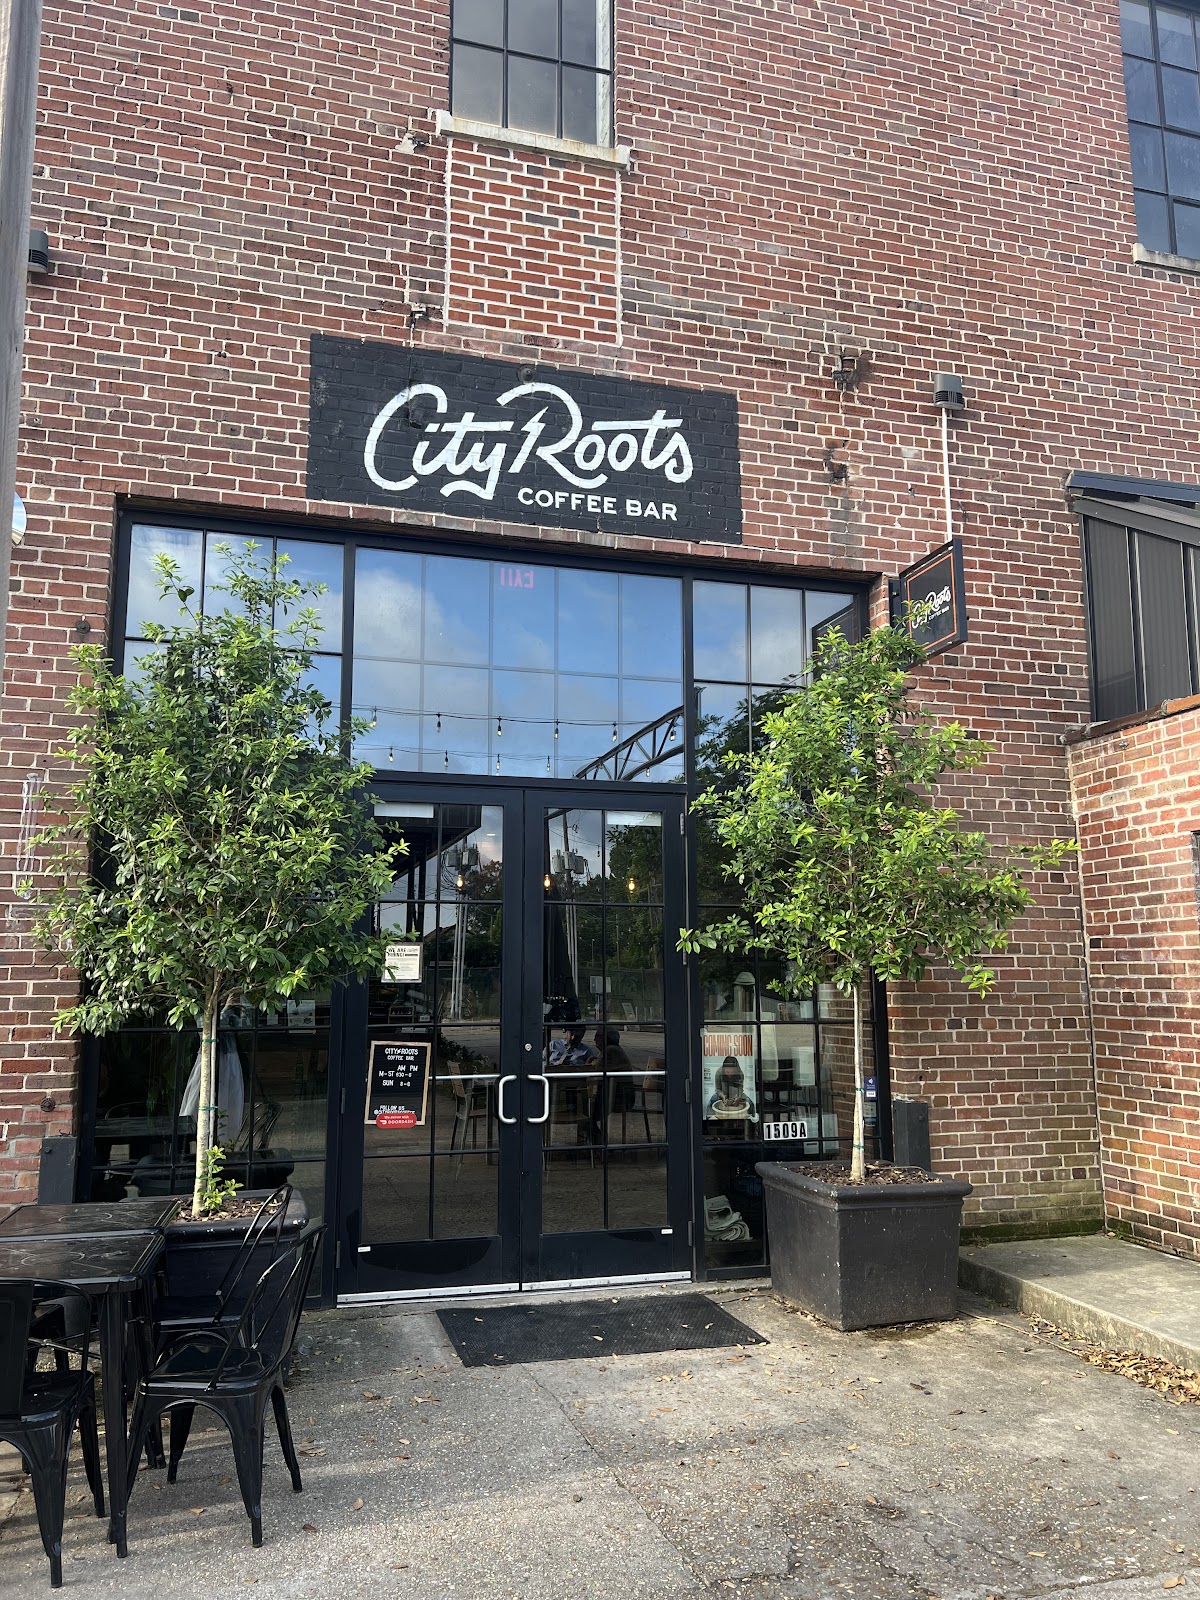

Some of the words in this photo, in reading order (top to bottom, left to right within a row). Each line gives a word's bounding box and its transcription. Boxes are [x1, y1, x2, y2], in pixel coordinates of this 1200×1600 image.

[364, 383, 514, 500] City
[496, 382, 693, 489] Roots
[517, 488, 617, 515] COFFEE
[625, 498, 679, 521] BAR
[924, 586, 951, 614] Roots
[703, 1034, 732, 1057] COMING
[733, 1034, 753, 1057] SOON
[766, 1122, 807, 1139] 1509A
